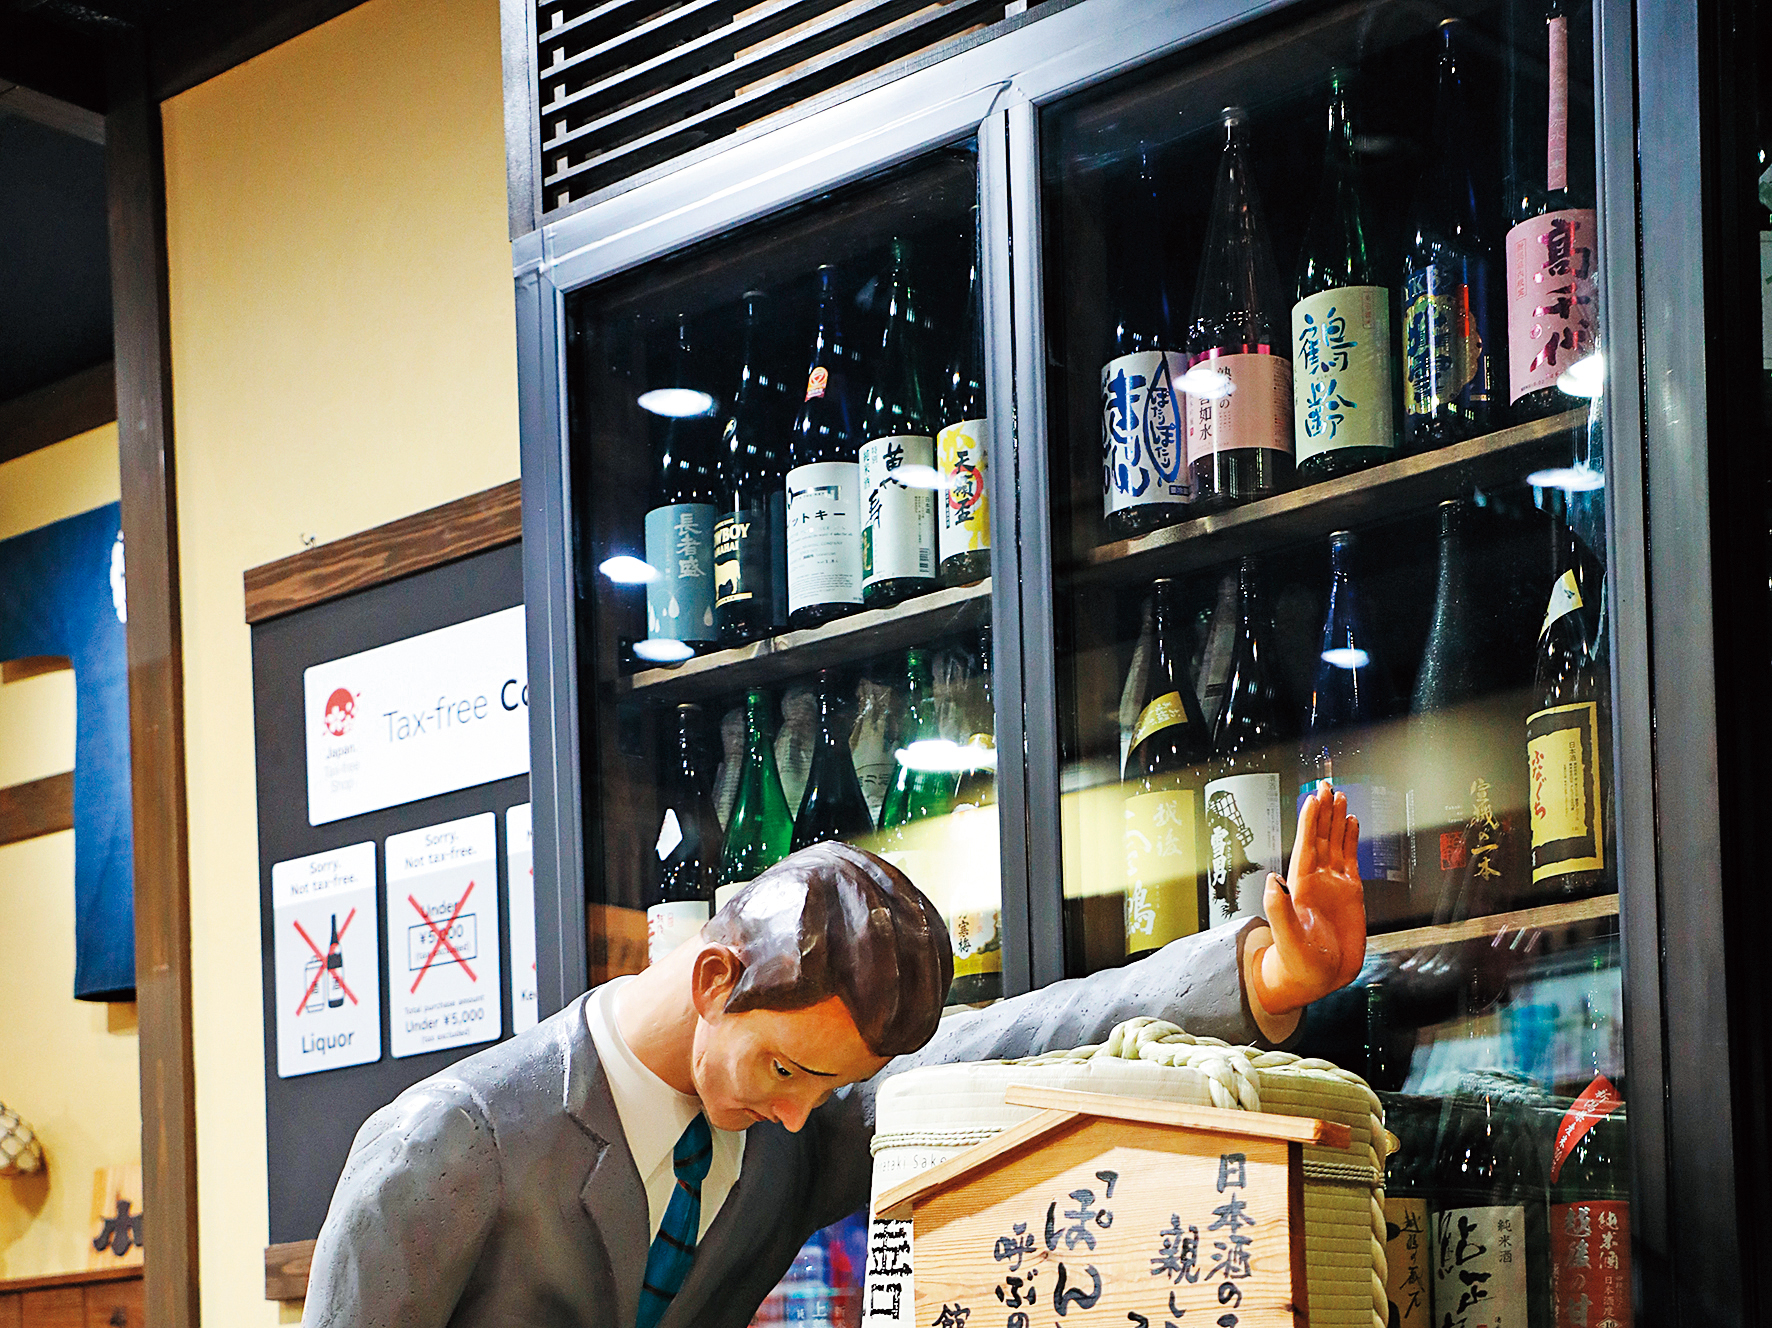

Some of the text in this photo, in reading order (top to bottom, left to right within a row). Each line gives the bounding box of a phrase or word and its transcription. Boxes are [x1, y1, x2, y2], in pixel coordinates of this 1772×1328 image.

[1298, 306, 1358, 440] 鶴齢
[674, 512, 706, 579] 長者盛
[383, 695, 488, 743] Tax-free
[405, 856, 424, 869] Not
[291, 882, 309, 896] Not
[405, 1007, 485, 1033] Under ¥5,000
[302, 1031, 355, 1056] Liquor
[1497, 1219, 1512, 1264] 純米酒
